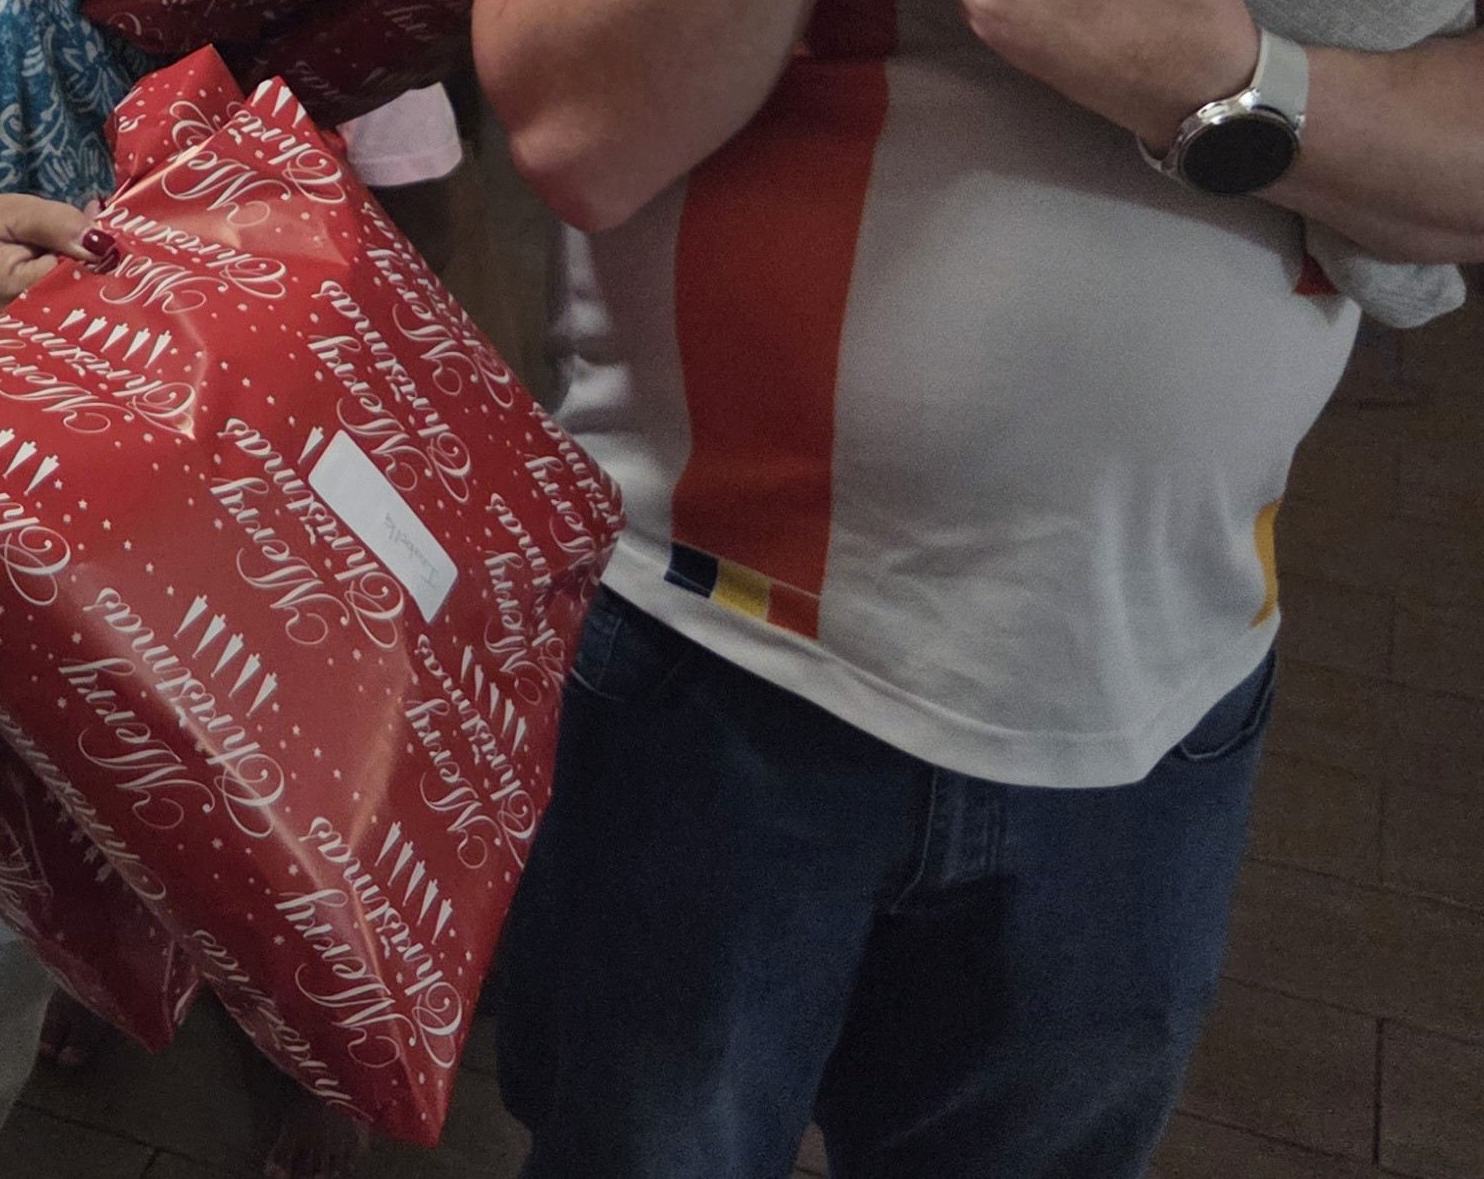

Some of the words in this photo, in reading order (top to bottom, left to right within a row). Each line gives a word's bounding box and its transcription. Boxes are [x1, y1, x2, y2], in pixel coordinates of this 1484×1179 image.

[311, 280, 471, 504] Christmas
[366, 242, 478, 396] Merry
[306, 334, 433, 492] Merry
[209, 476, 350, 646] Merry
[217, 418, 405, 649] Christmas
[82, 586, 286, 838] Christmas
[483, 549, 549, 706] Merry
[58, 657, 216, 830] Merry
[404, 697, 503, 870] Merry
[415, 633, 537, 869] Christmas
[275, 887, 418, 1070] Merry
[298, 816, 464, 1070] Christmas
